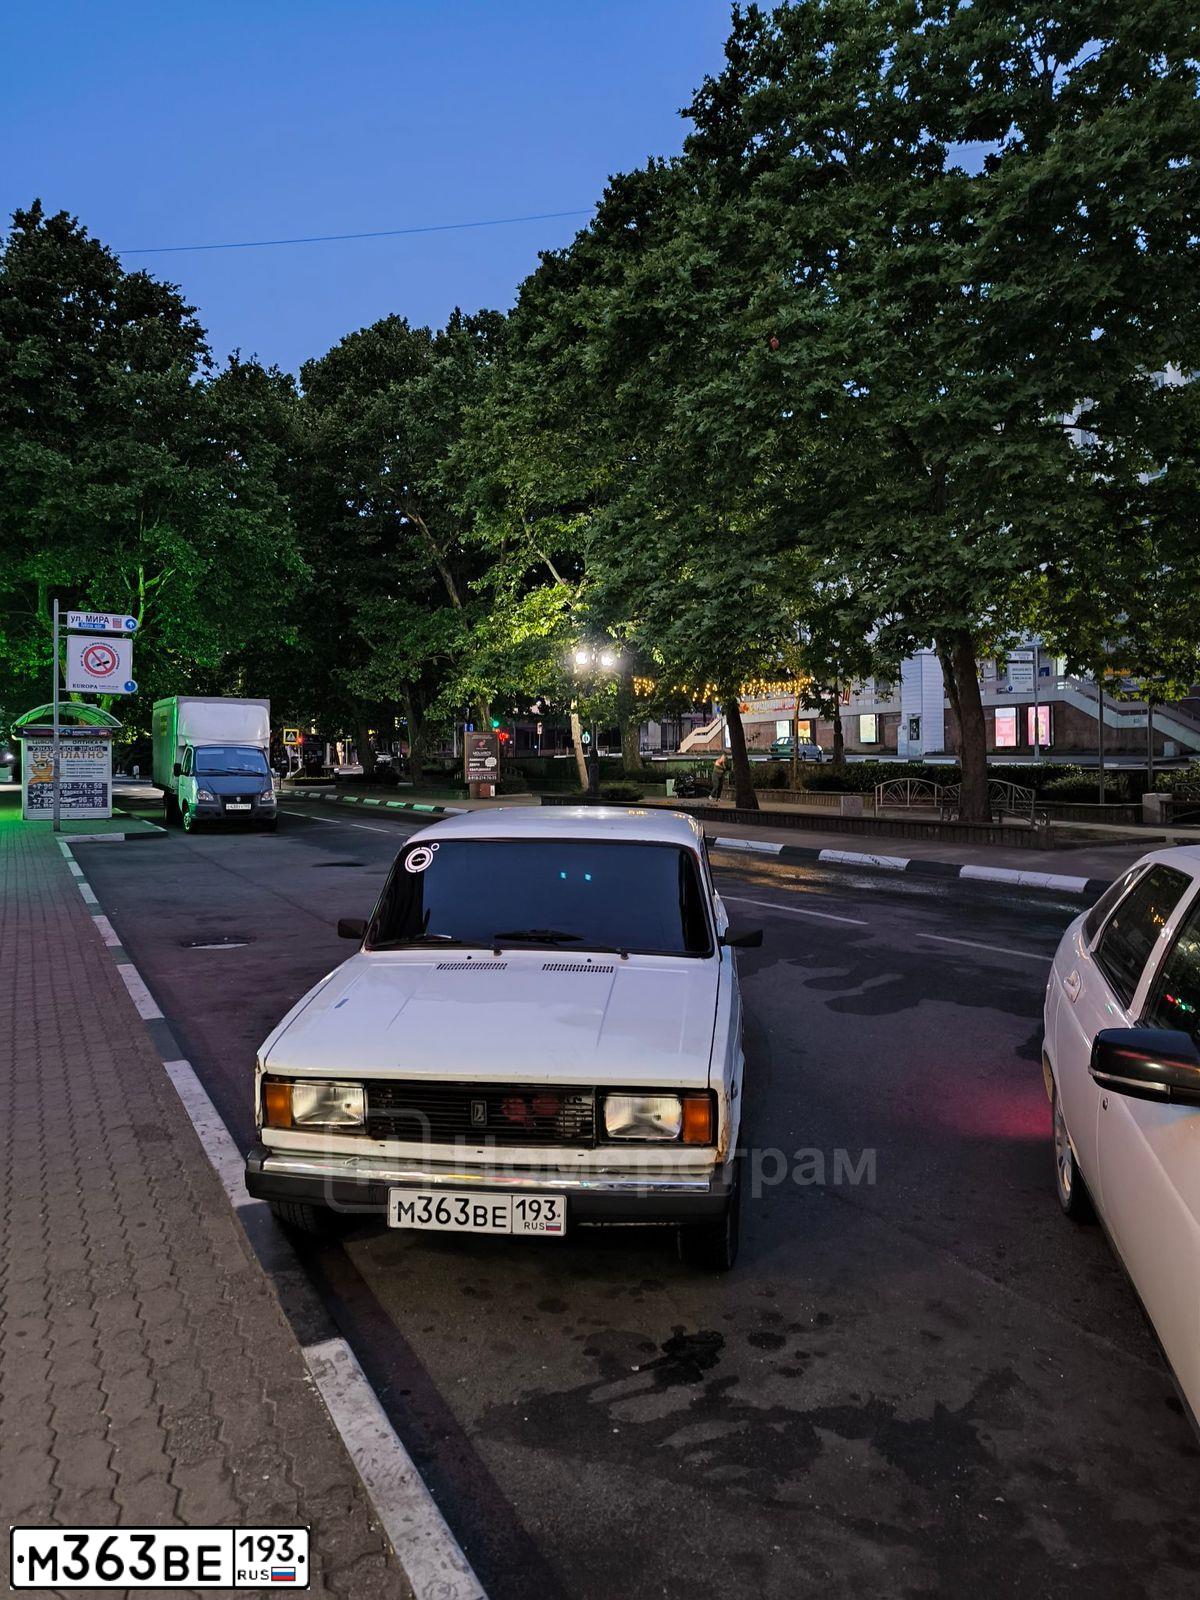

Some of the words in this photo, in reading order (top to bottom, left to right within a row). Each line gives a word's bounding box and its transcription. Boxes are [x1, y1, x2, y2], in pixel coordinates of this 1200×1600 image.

[70, 615, 83, 623] ул.
[85, 615, 110, 624] МИРА
[397, 1195, 507, 1228] М363ВЕ
[515, 1199, 556, 1221] 193
[523, 1221, 546, 1231] RUS
